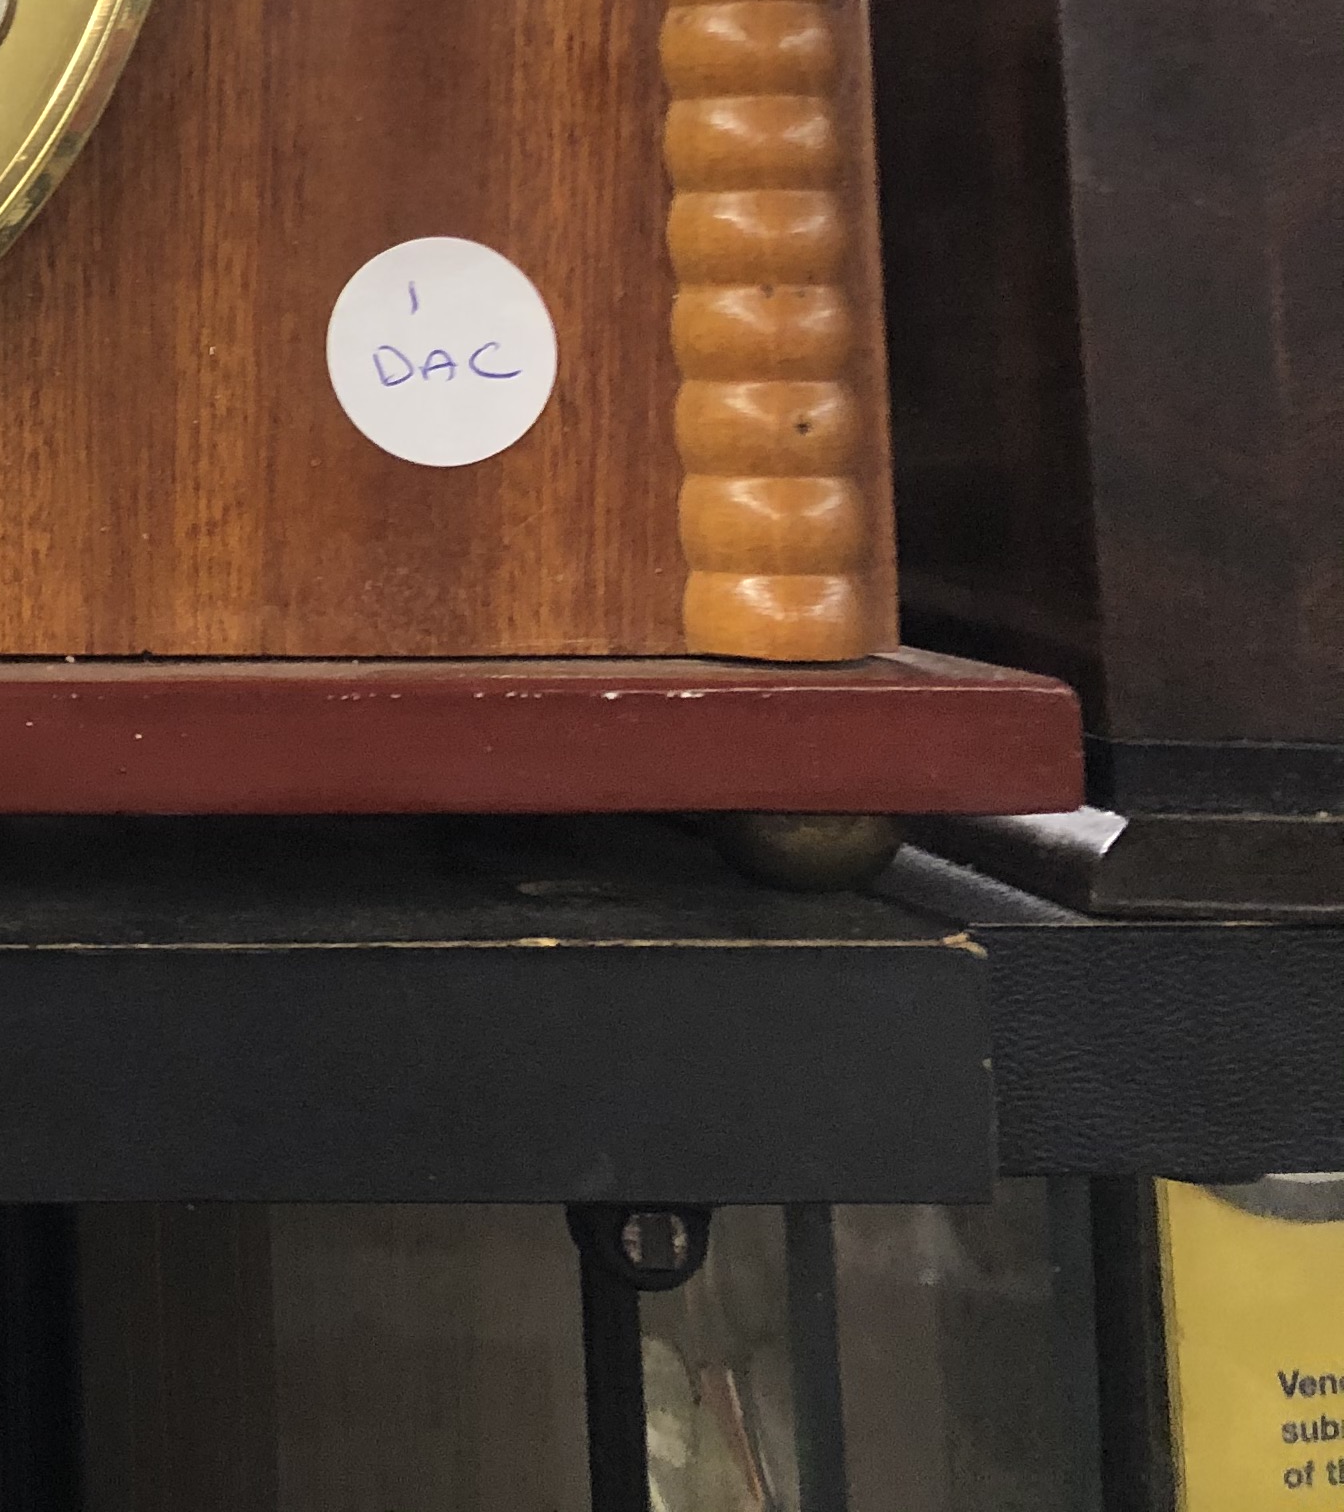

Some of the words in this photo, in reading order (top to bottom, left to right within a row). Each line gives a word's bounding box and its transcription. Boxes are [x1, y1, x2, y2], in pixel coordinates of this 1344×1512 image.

[373, 342, 522, 387] DAC
[1281, 1413, 1344, 1444] sub
[1283, 1460, 1315, 1489] of
